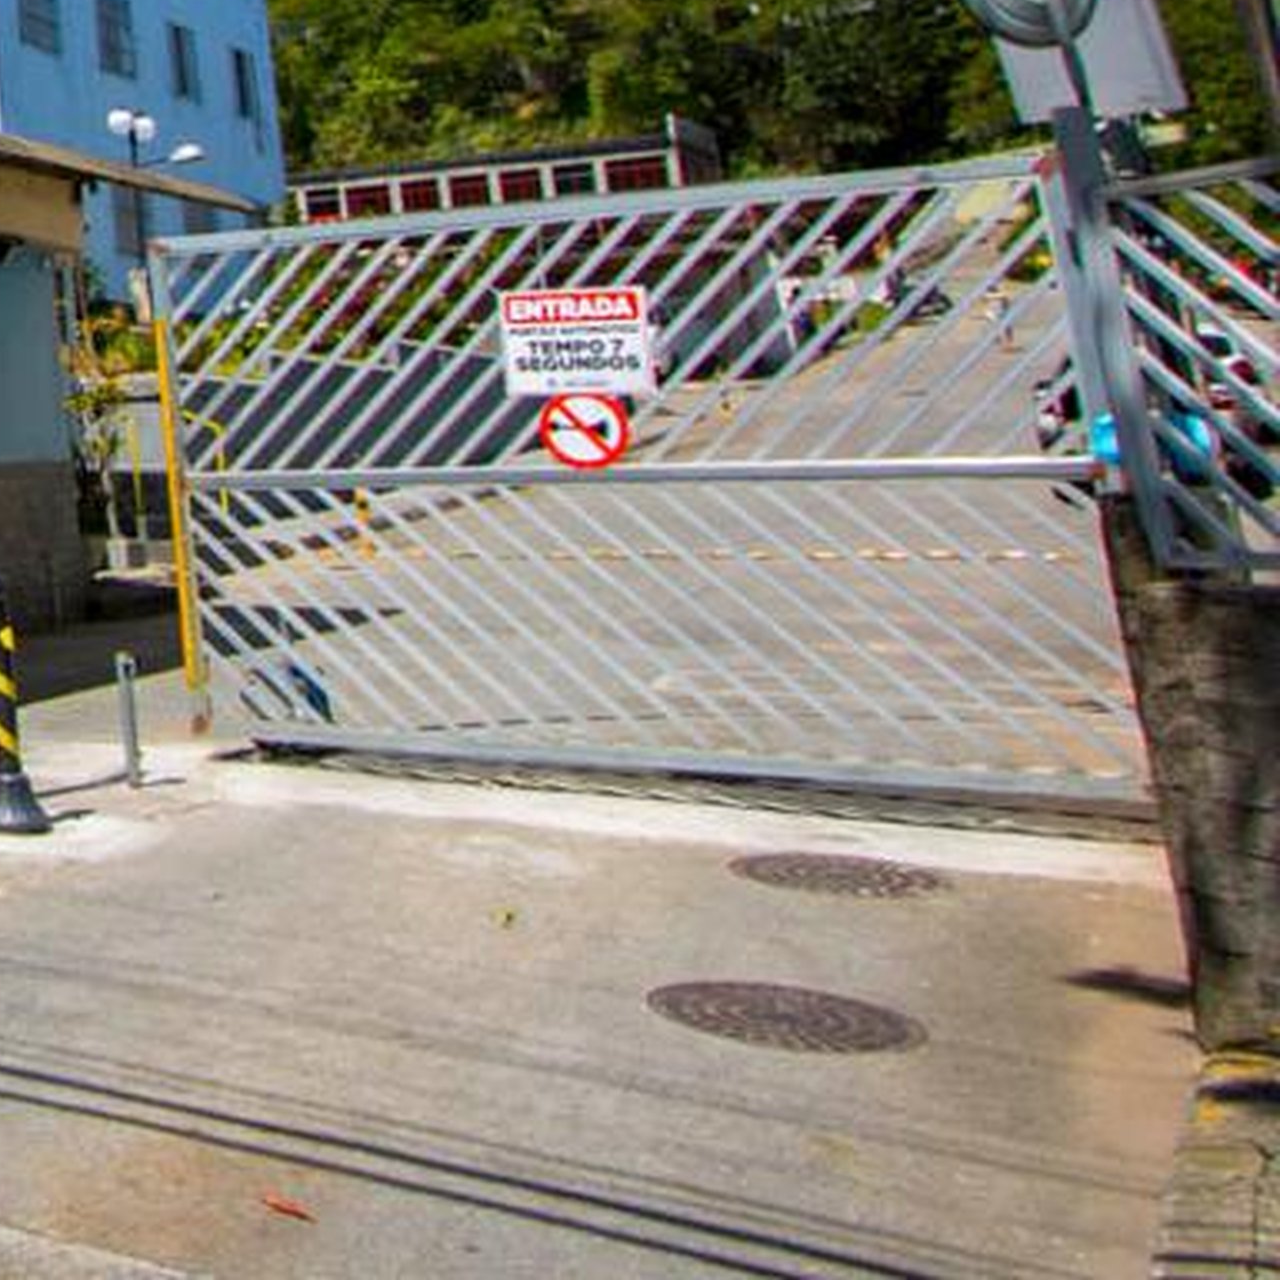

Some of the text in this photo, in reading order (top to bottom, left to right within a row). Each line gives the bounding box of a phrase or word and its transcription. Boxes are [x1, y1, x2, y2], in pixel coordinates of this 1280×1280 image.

[509, 296, 633, 320] ENTRADA
[528, 338, 625, 354] TEMPO 7
[515, 355, 640, 371] SEGUNDOS
